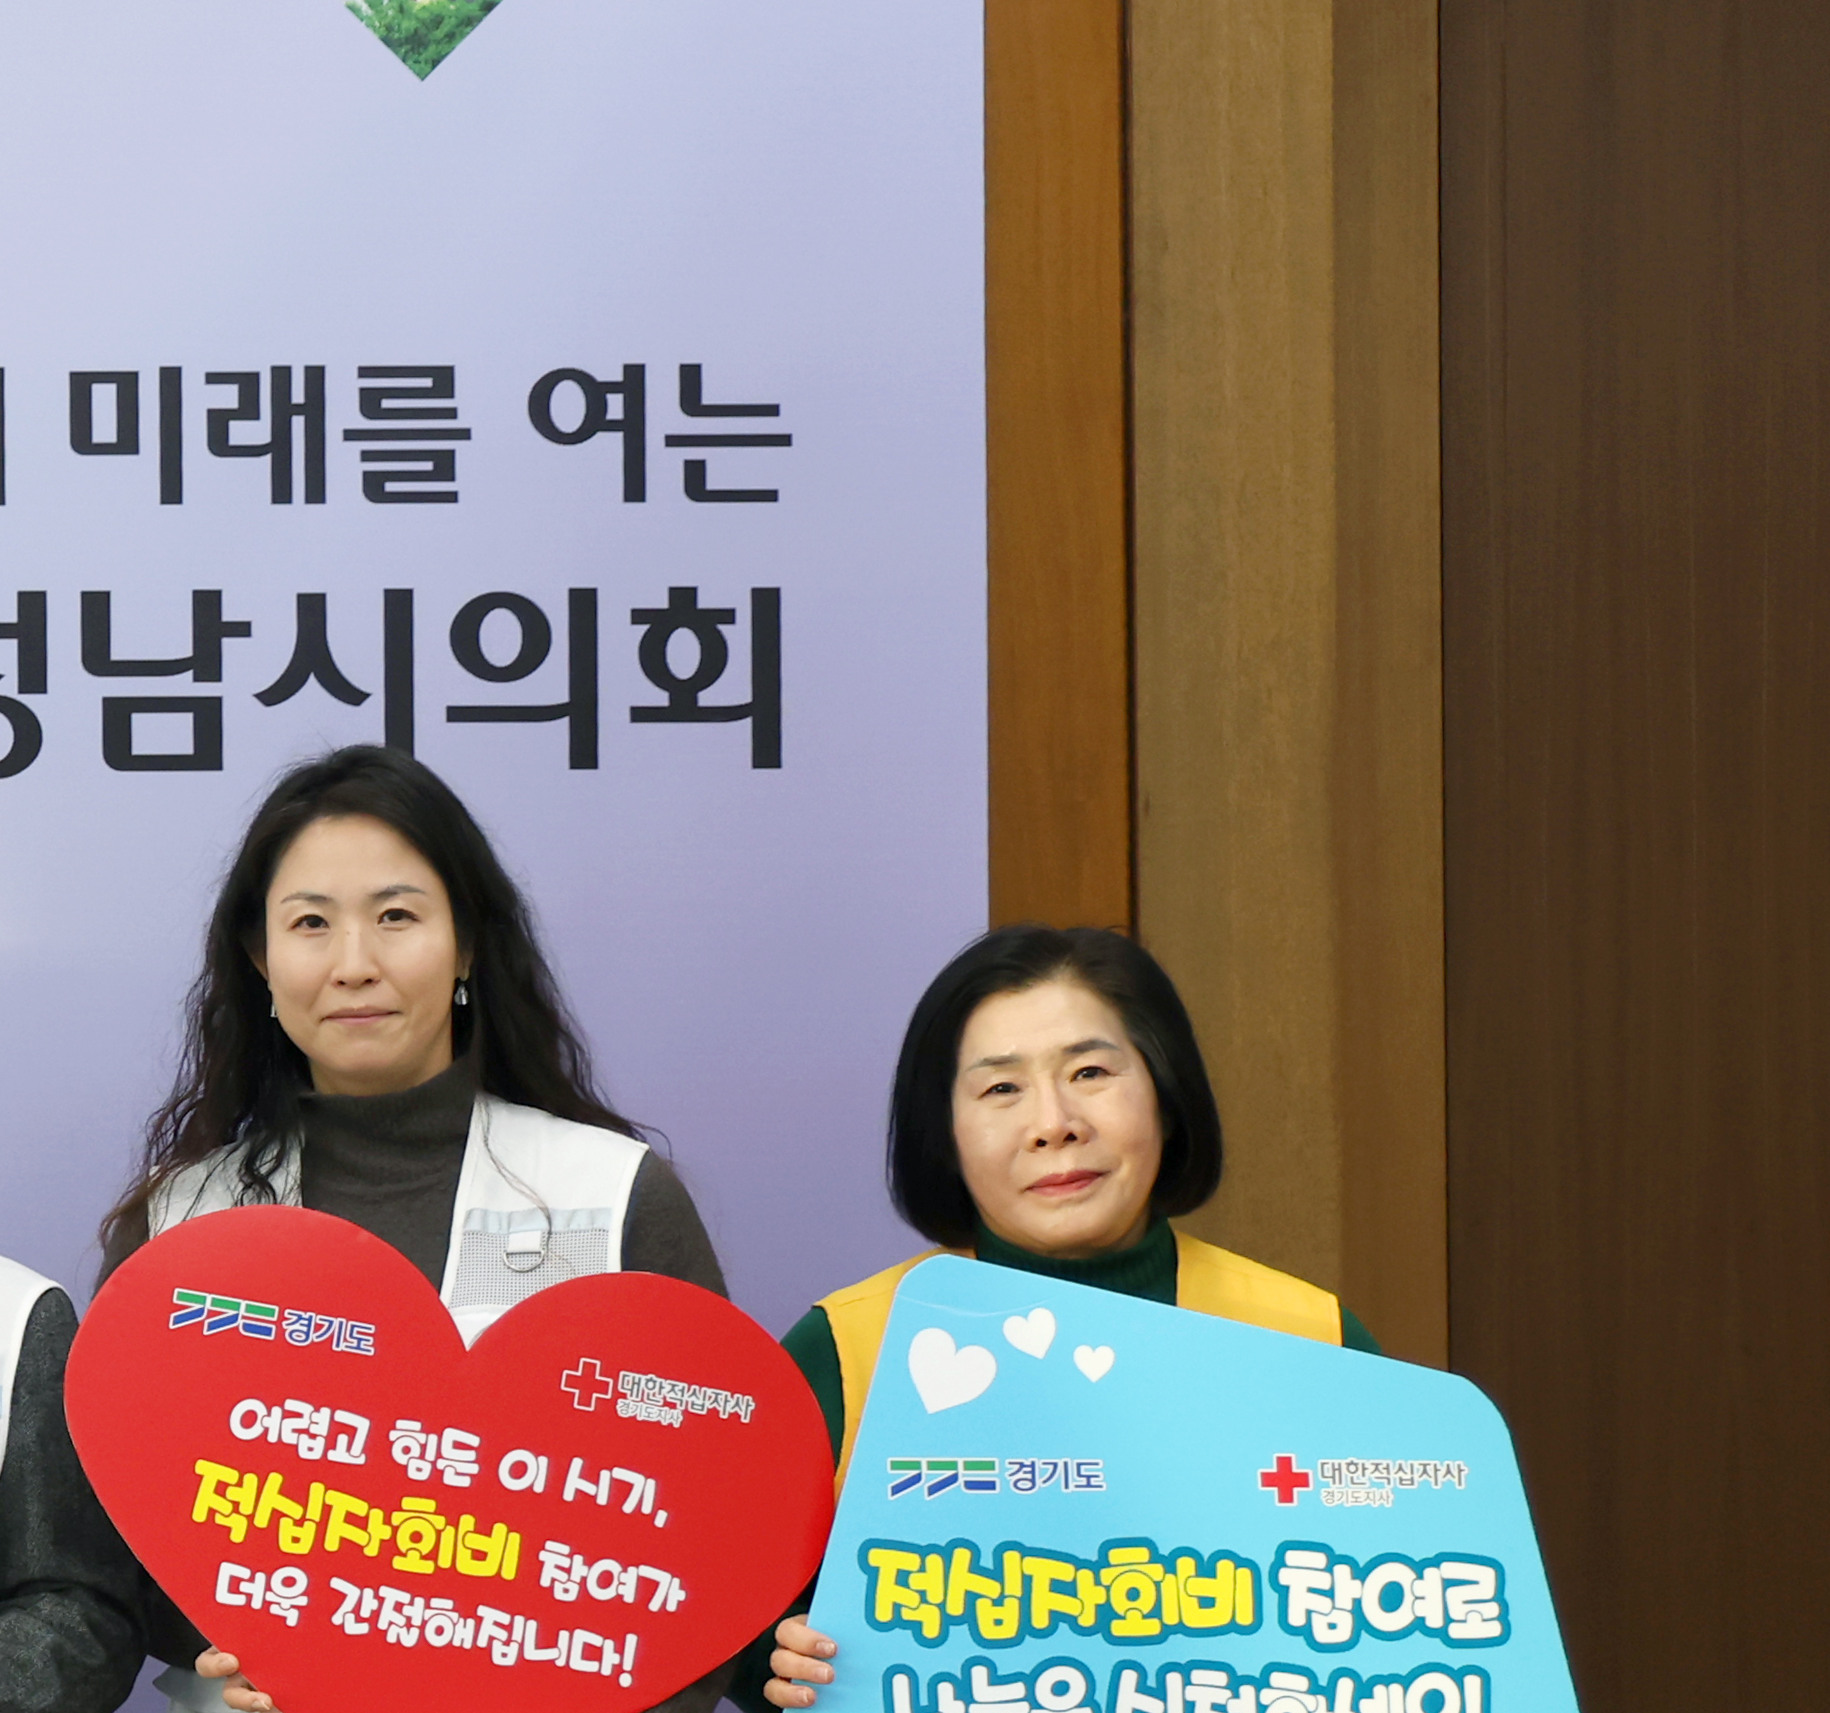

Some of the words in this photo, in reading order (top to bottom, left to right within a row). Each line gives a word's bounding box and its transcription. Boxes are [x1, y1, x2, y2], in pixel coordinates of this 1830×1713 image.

[67, 364, 474, 507] 미래를
[526, 361, 792, 504] 여는
[281, 1309, 376, 1355] 경기도
[616, 1399, 683, 1428] 경기도지사
[617, 1371, 754, 1423] 대한적십자사
[229, 1398, 370, 1466] 어렵고
[389, 1419, 481, 1488] 힘든
[497, 1449, 548, 1494] 이
[562, 1457, 668, 1528] 시기,
[1006, 1458, 1106, 1492] 경기도
[1318, 1458, 1467, 1491] 대한적십자사
[1321, 1488, 1394, 1507] 경기도지사
[191, 1459, 521, 1581] 적십자회비
[538, 1541, 686, 1614] 참여가
[866, 1546, 1253, 1640] 적십자회비
[1278, 1550, 1502, 1642] 참여로
[214, 1562, 309, 1627] 더욱
[329, 1576, 638, 1688] 간절해집니다!
